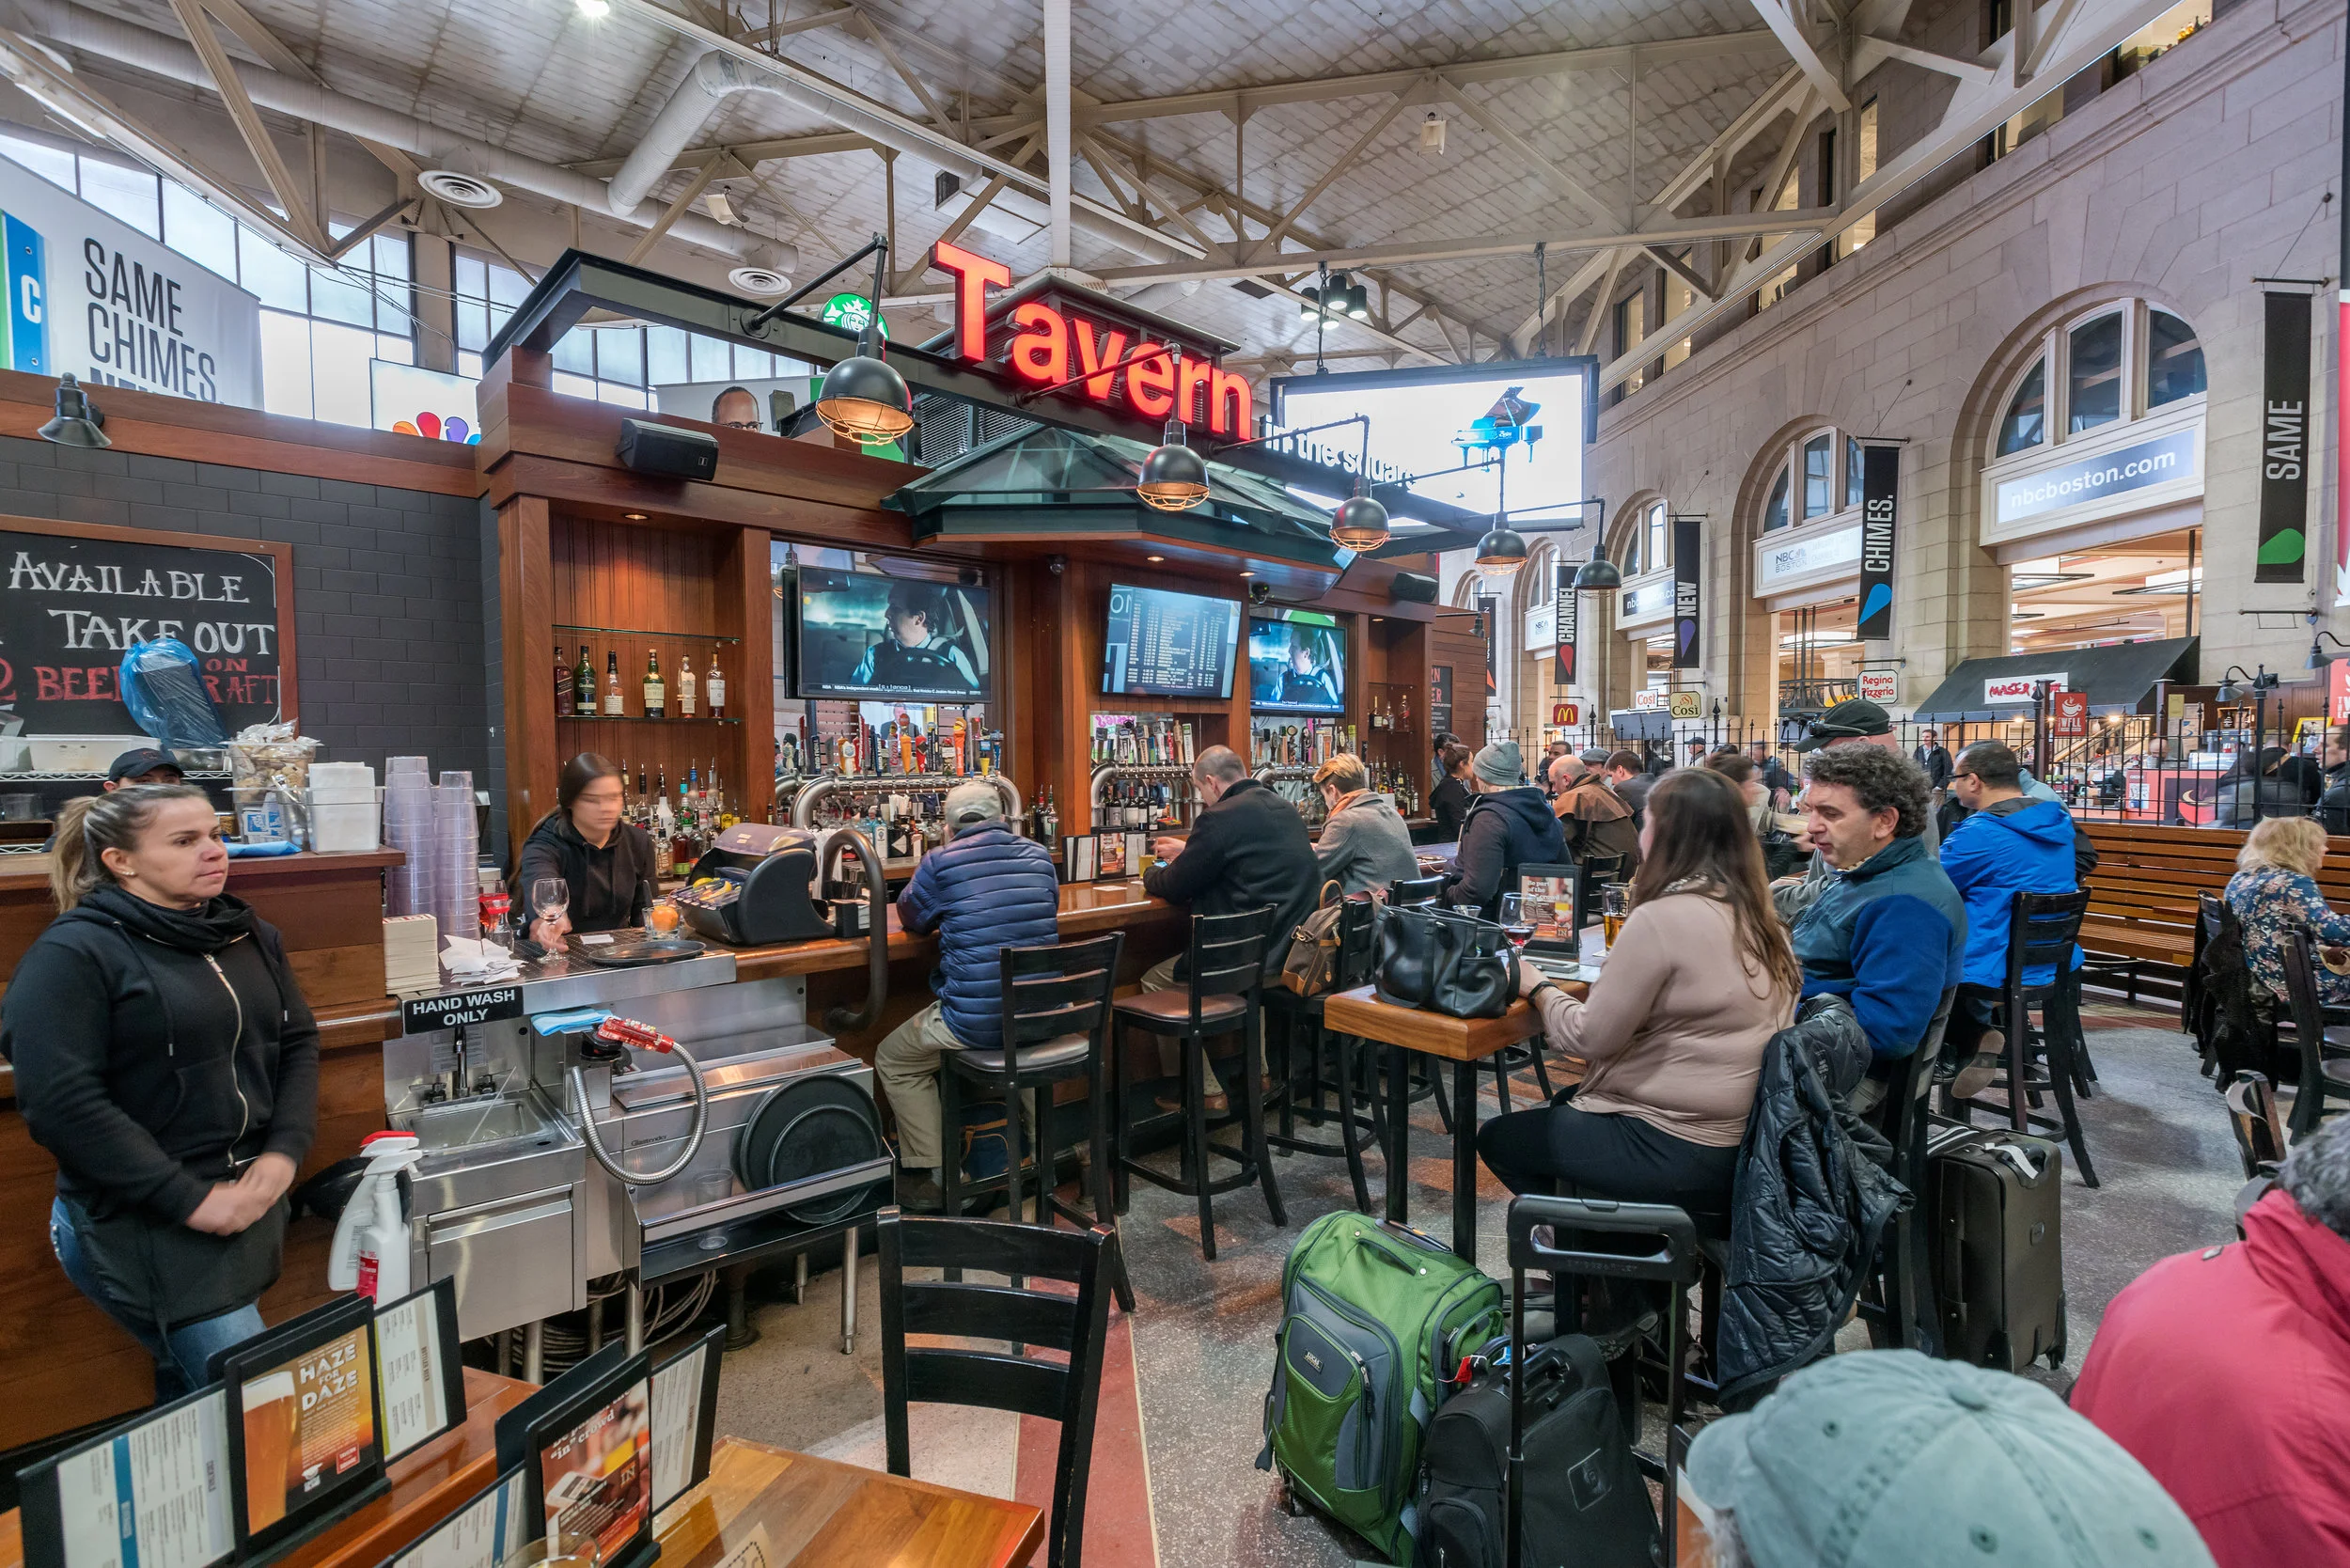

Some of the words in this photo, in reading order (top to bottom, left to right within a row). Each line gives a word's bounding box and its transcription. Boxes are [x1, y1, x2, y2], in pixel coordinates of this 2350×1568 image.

[21, 274, 41, 324] C
[85, 238, 183, 337] SAME
[929, 241, 1252, 440] Tavern
[1261, 414, 1293, 453] in
[1295, 432, 1340, 467] the
[1342, 449, 1417, 490] square
[2265, 400, 2303, 481] SAME
[2011, 451, 2176, 508] nbcboston.com
[1864, 494, 1894, 573] CHIMES.
[1776, 550, 1794, 564] NBC
[8, 552, 250, 604] AVAILABLE
[1677, 581, 1697, 617] NEW
[47, 609, 184, 651] TAKE
[194, 621, 275, 655] OUT
[205, 658, 248, 672] ON
[1862, 676, 1893, 686] Regina
[202, 675, 278, 705] RAFT
[1861, 686, 1894, 698] Pizzeria
[1989, 682, 2030, 697] MASTER
[1671, 705, 1699, 715] Così
[2061, 717, 2081, 728] WELL
[414, 997, 462, 1015] HAND
[466, 989, 515, 1007] WASH
[443, 1009, 489, 1026] ONLY
[300, 1343, 356, 1385] HAZE
[319, 1369, 340, 1386] FOR
[302, 1370, 357, 1411] DAZE
[578, 1409, 615, 1444] crowd
[620, 1466, 636, 1485] IN
